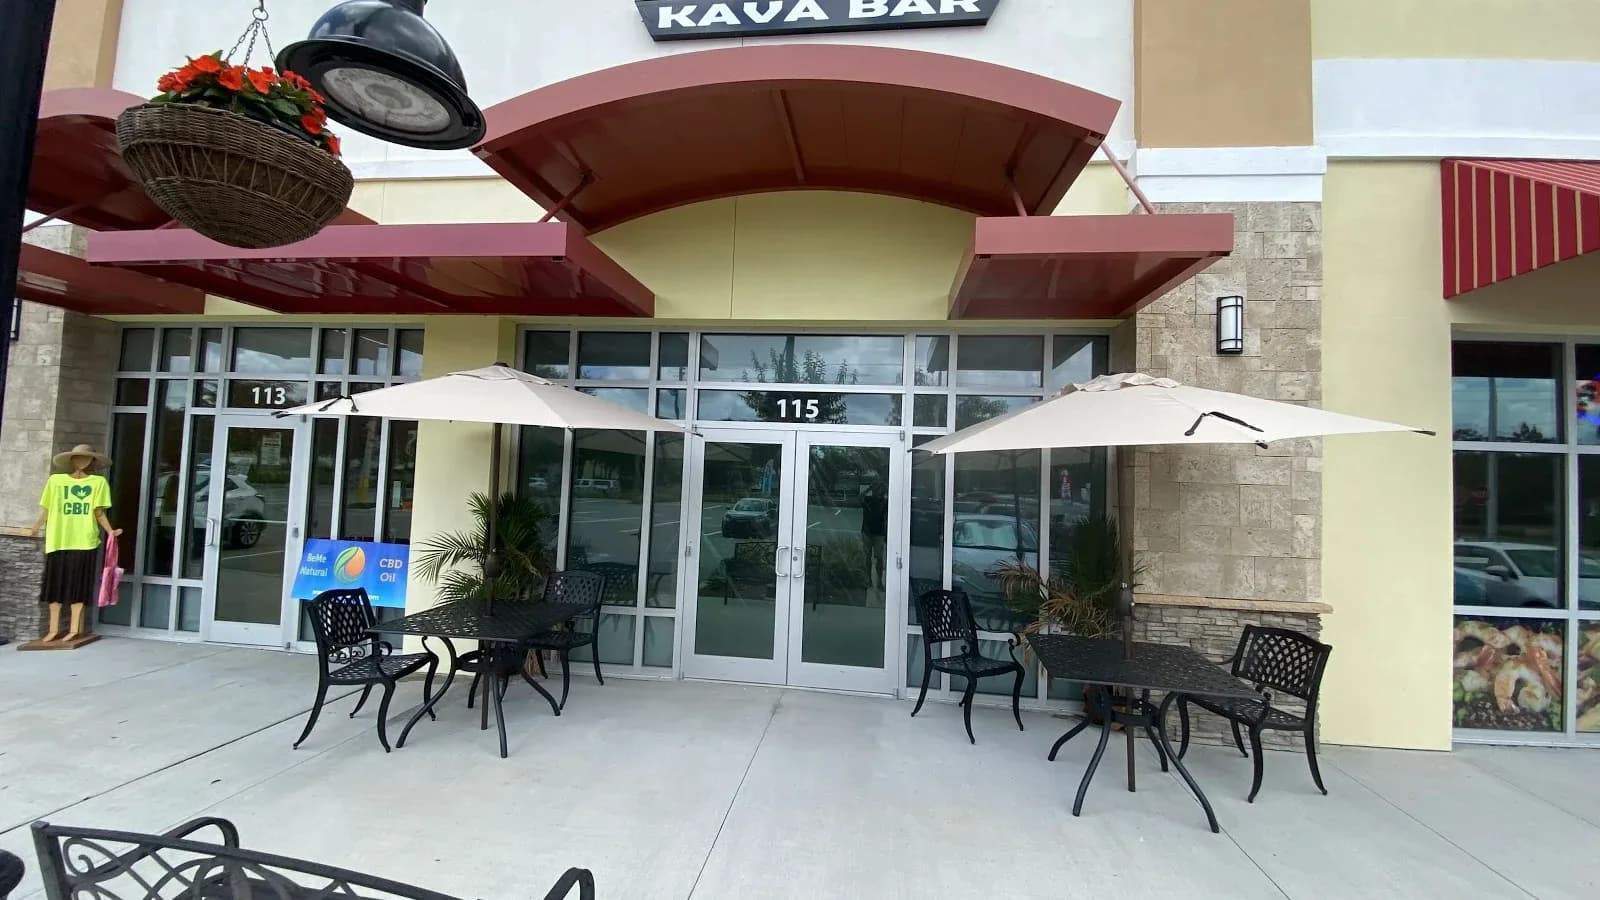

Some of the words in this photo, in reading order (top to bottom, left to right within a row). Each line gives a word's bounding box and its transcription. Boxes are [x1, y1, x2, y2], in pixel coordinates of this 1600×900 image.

[658, 0, 829, 28] KAVA
[848, 0, 981, 18] BAR
[252, 387, 286, 405] 113
[777, 399, 819, 419] 115
[64, 485, 69, 499] I
[63, 502, 90, 515] CBD
[307, 553, 327, 563] BeMe
[379, 558, 403, 569] CBD
[300, 567, 328, 577] Natural
[380, 572, 396, 583] Oil
